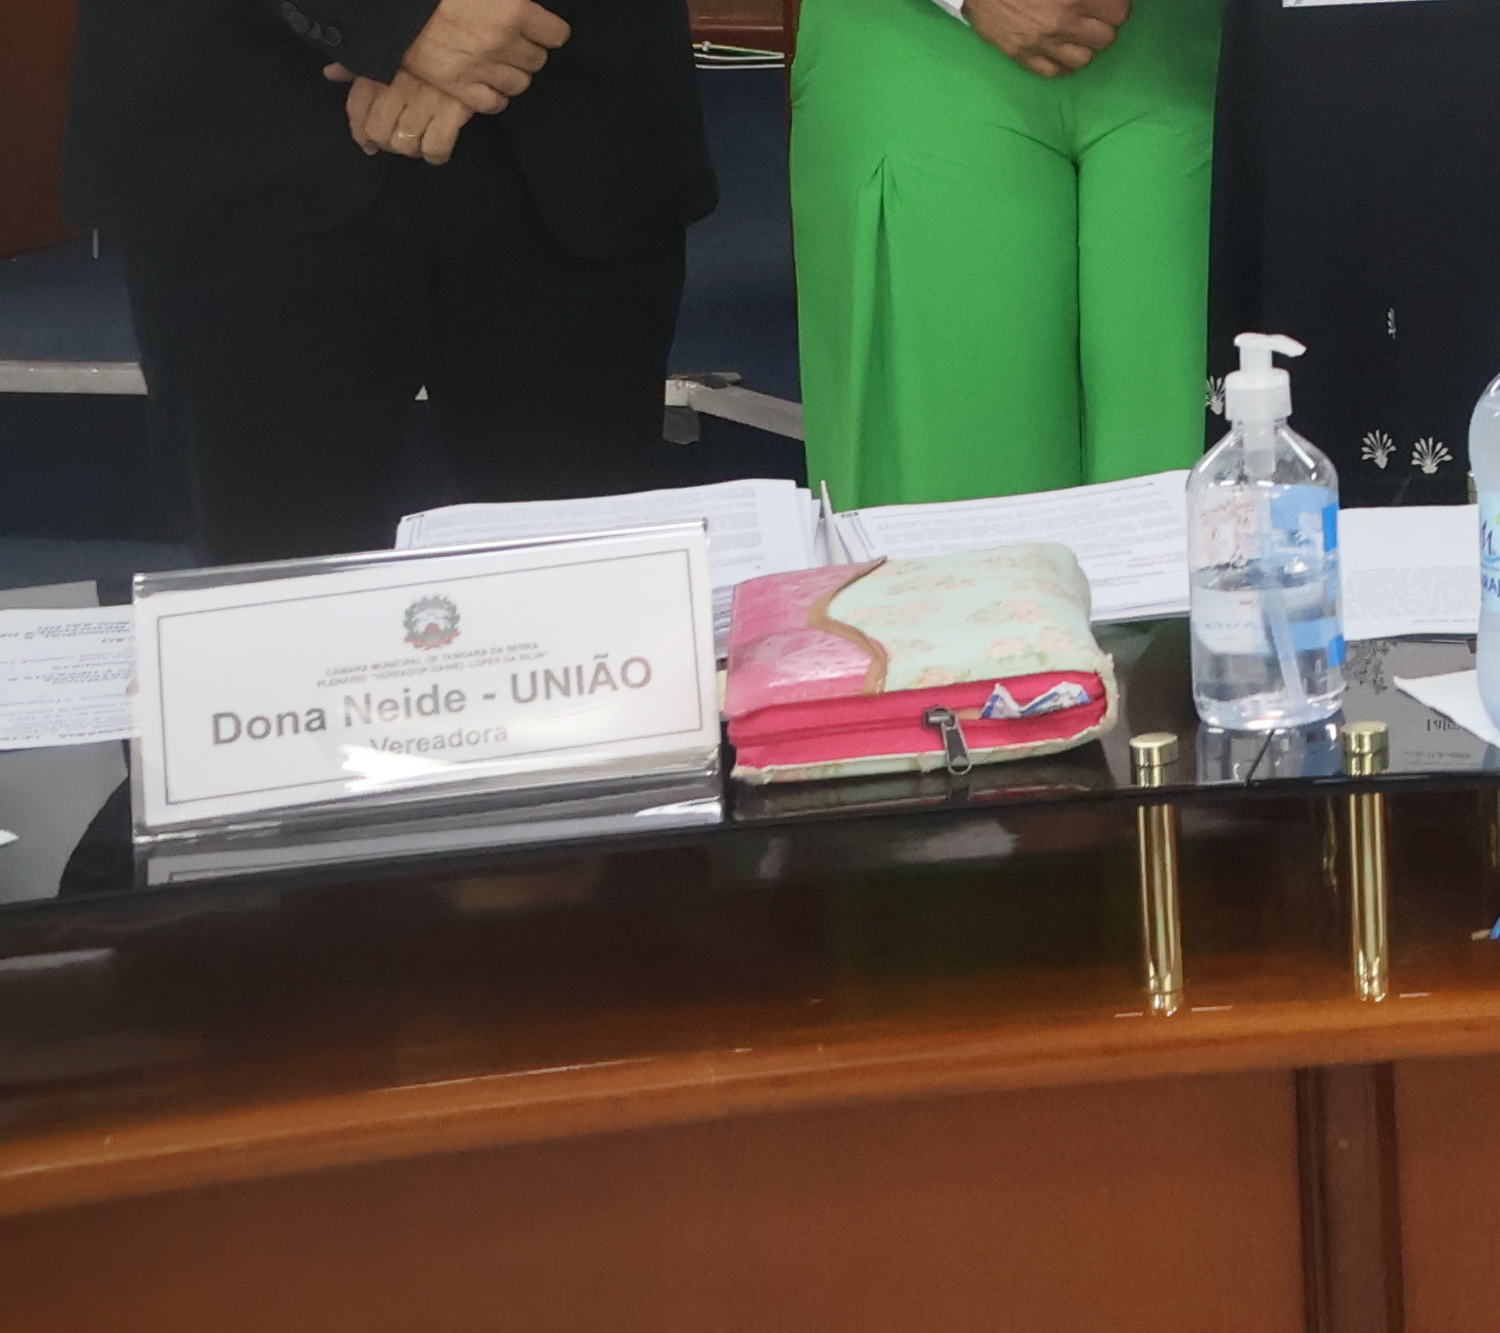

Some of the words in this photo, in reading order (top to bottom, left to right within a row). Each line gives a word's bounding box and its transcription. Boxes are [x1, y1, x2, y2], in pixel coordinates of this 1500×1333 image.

[212, 705, 328, 746] Dona
[344, 684, 466, 728] Neide
[483, 692, 496, 700] -
[511, 653, 652, 705] UNIÃO
[369, 725, 507, 754] Vereadora
